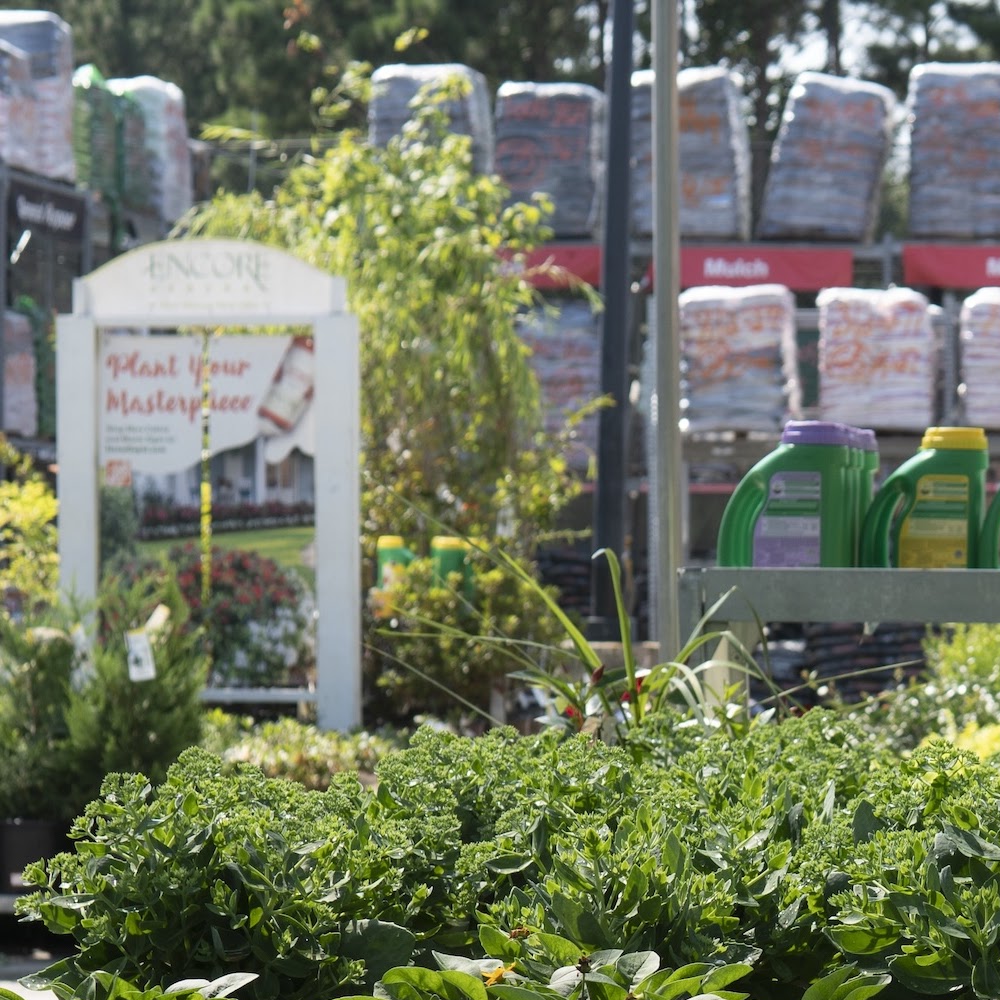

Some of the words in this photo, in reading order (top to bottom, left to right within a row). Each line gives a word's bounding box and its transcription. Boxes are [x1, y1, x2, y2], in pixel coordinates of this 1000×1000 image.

[146, 251, 270, 290] ENCORE
[703, 257, 770, 279] Mulch
[106, 350, 178, 381] Plant
[189, 353, 251, 387] Your
[106, 388, 251, 424] Masterpiece
